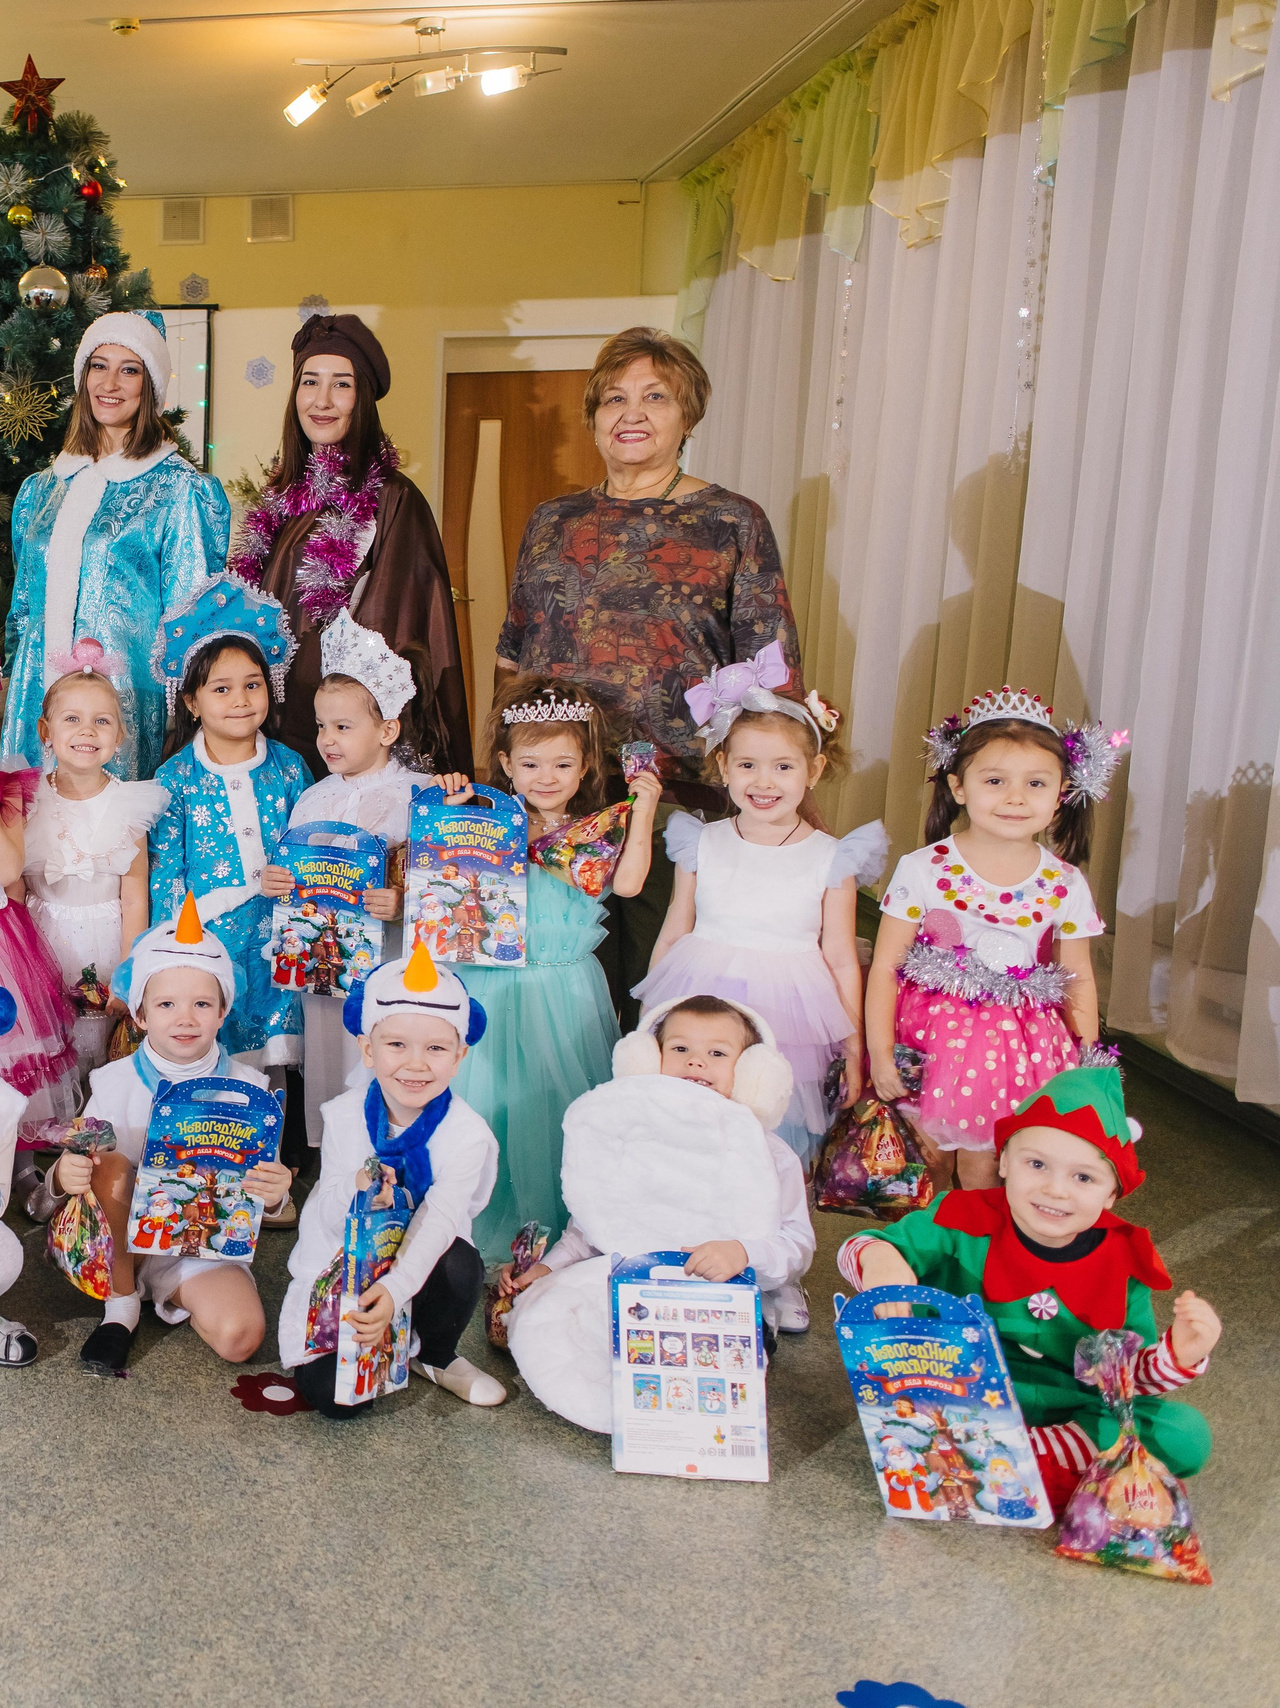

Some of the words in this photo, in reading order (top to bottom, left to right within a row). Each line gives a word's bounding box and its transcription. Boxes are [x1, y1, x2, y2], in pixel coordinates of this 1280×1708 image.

[434, 820, 508, 840] НОВОГОДНИЙ
[443, 834, 498, 851] ПОДАРОК
[419, 856, 429, 865] 18
[293, 860, 364, 881] НОВОГОДНИЙ
[302, 874, 354, 890] ПОДАРОК
[280, 894, 290, 902] 18
[176, 1120, 258, 1140] НОВОГОДНИЙ
[184, 1134, 244, 1150] ПОДАРОК
[154, 1155, 164, 1164] 18
[214, 1149, 234, 1160] МОРОЗА
[864, 1341, 962, 1364] НОВОГОДНИЙ
[881, 1358, 954, 1379] ПОДАРОК
[904, 1378, 922, 1386] ДЕДА
[924, 1379, 952, 1391] МОРОЗА
[862, 1388, 874, 1400] 18
